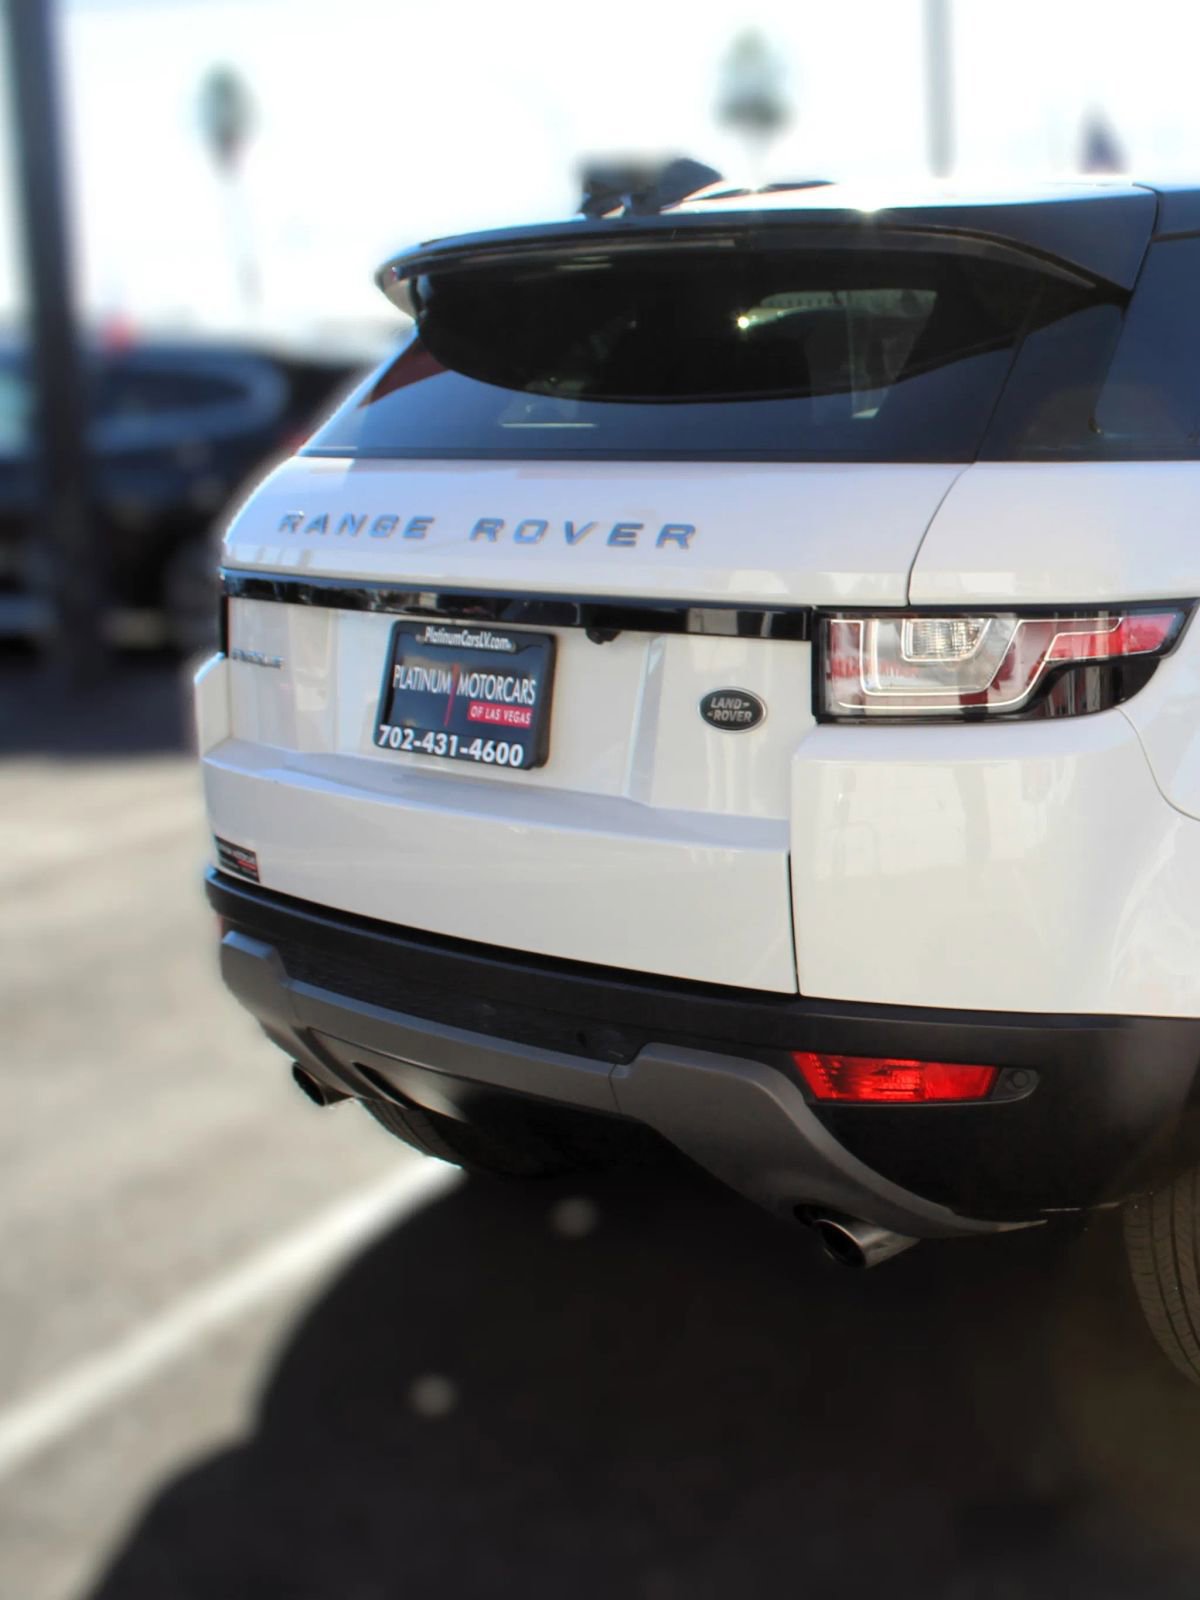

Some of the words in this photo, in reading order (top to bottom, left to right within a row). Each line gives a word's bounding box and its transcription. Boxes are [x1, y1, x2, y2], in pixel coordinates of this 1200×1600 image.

[277, 513, 435, 540] RANGE
[468, 517, 696, 550] ROVER
[424, 626, 511, 650] PlatinumCarsLV.com
[392, 664, 450, 695] PLATINUM
[456, 672, 537, 705] MOTORCARS
[470, 705, 482, 718] OF
[485, 707, 500, 721] LAS
[503, 709, 531, 724] VEGAS
[378, 724, 524, 767] 702-431-4600
